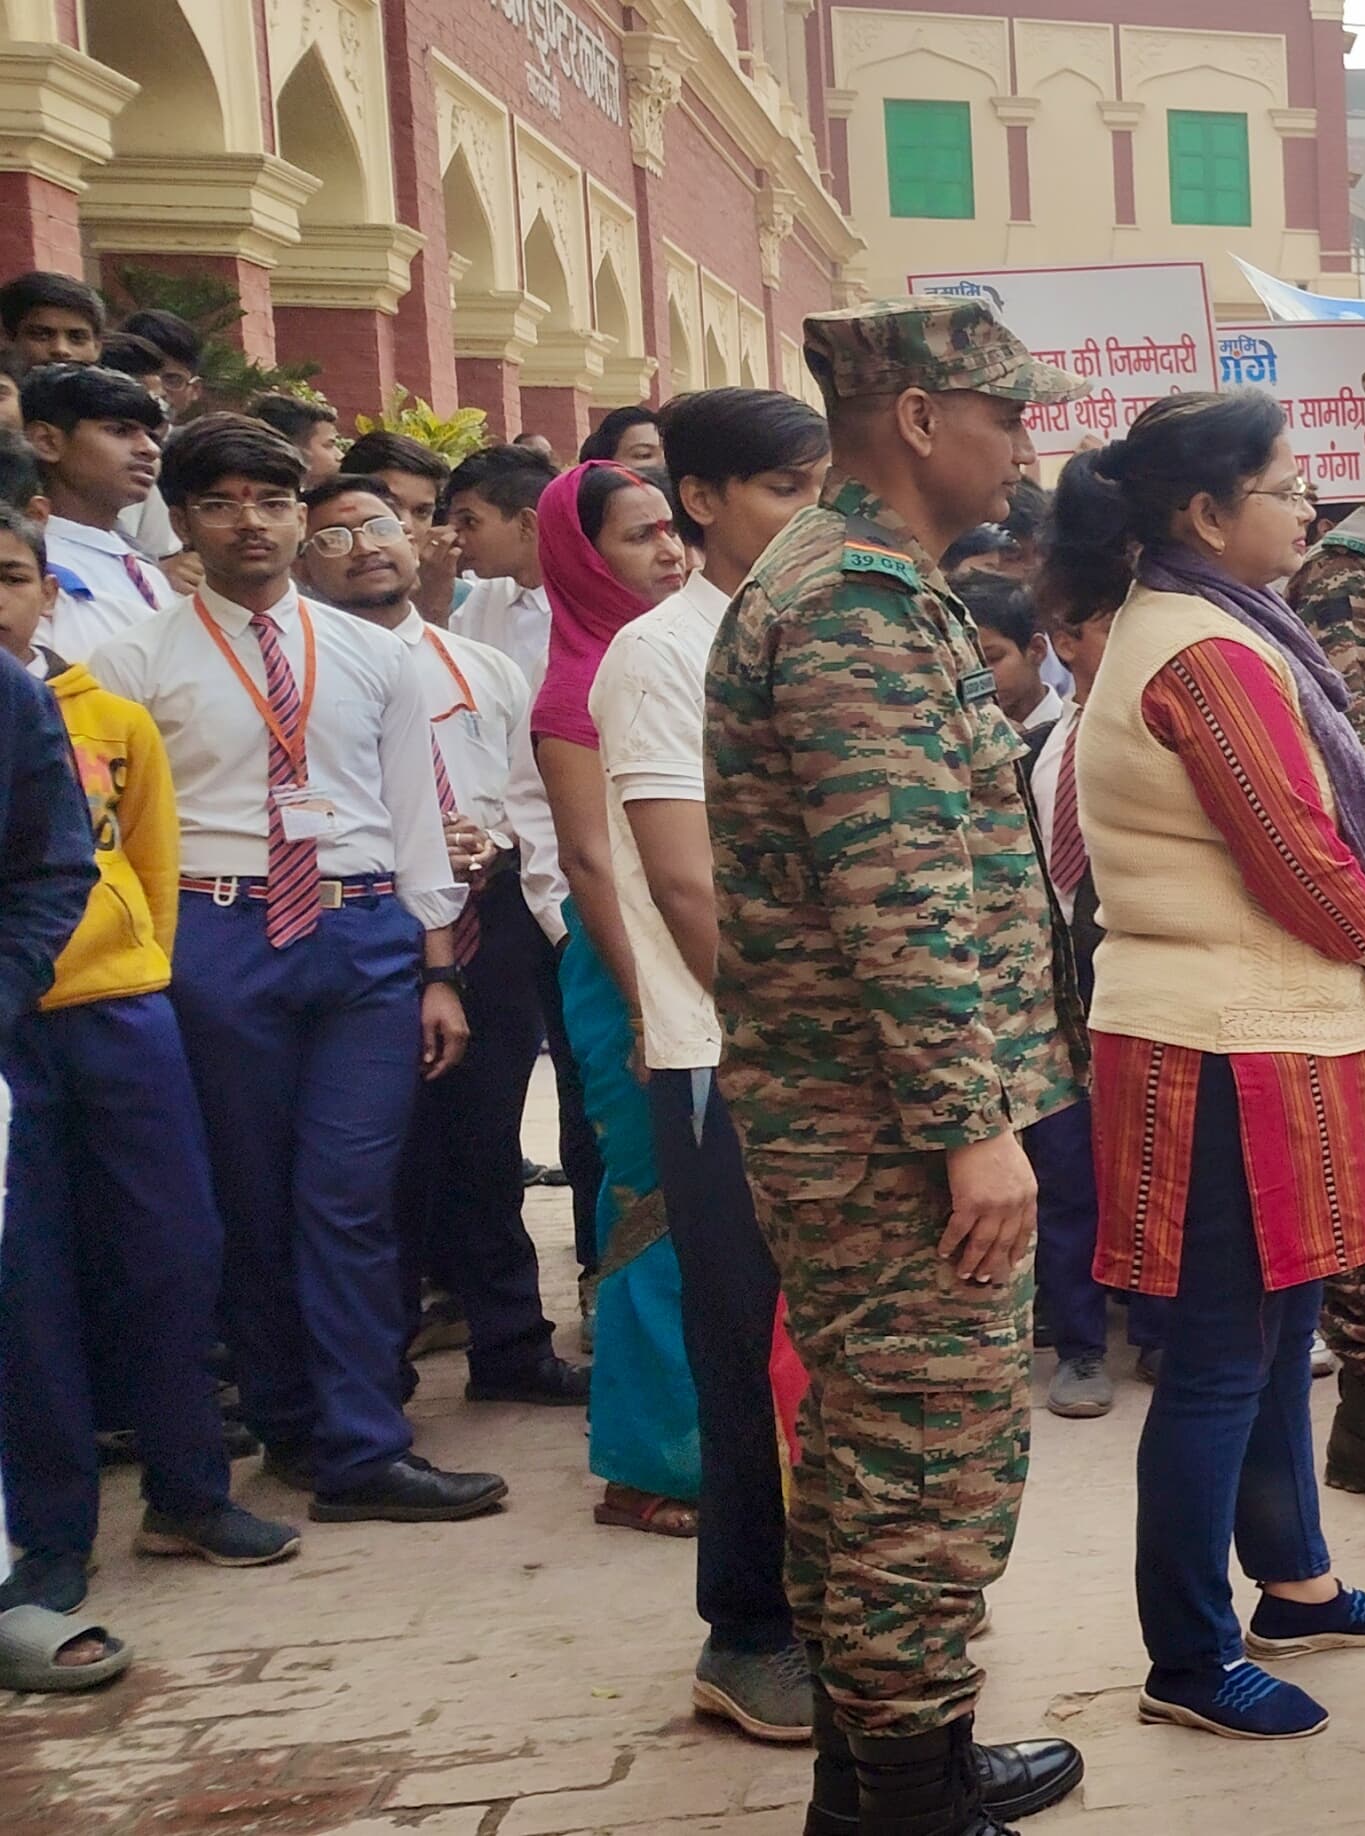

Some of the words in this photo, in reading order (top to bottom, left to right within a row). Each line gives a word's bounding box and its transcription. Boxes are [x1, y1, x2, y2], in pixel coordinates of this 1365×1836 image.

[1072, 337, 1101, 377] की
[1106, 333, 1197, 376] जिम्मेदारी
[1219, 334, 1257, 354] मामि
[1316, 440, 1360, 481] गंगा
[851, 554, 874, 567] 39
[881, 558, 906, 574] GR
